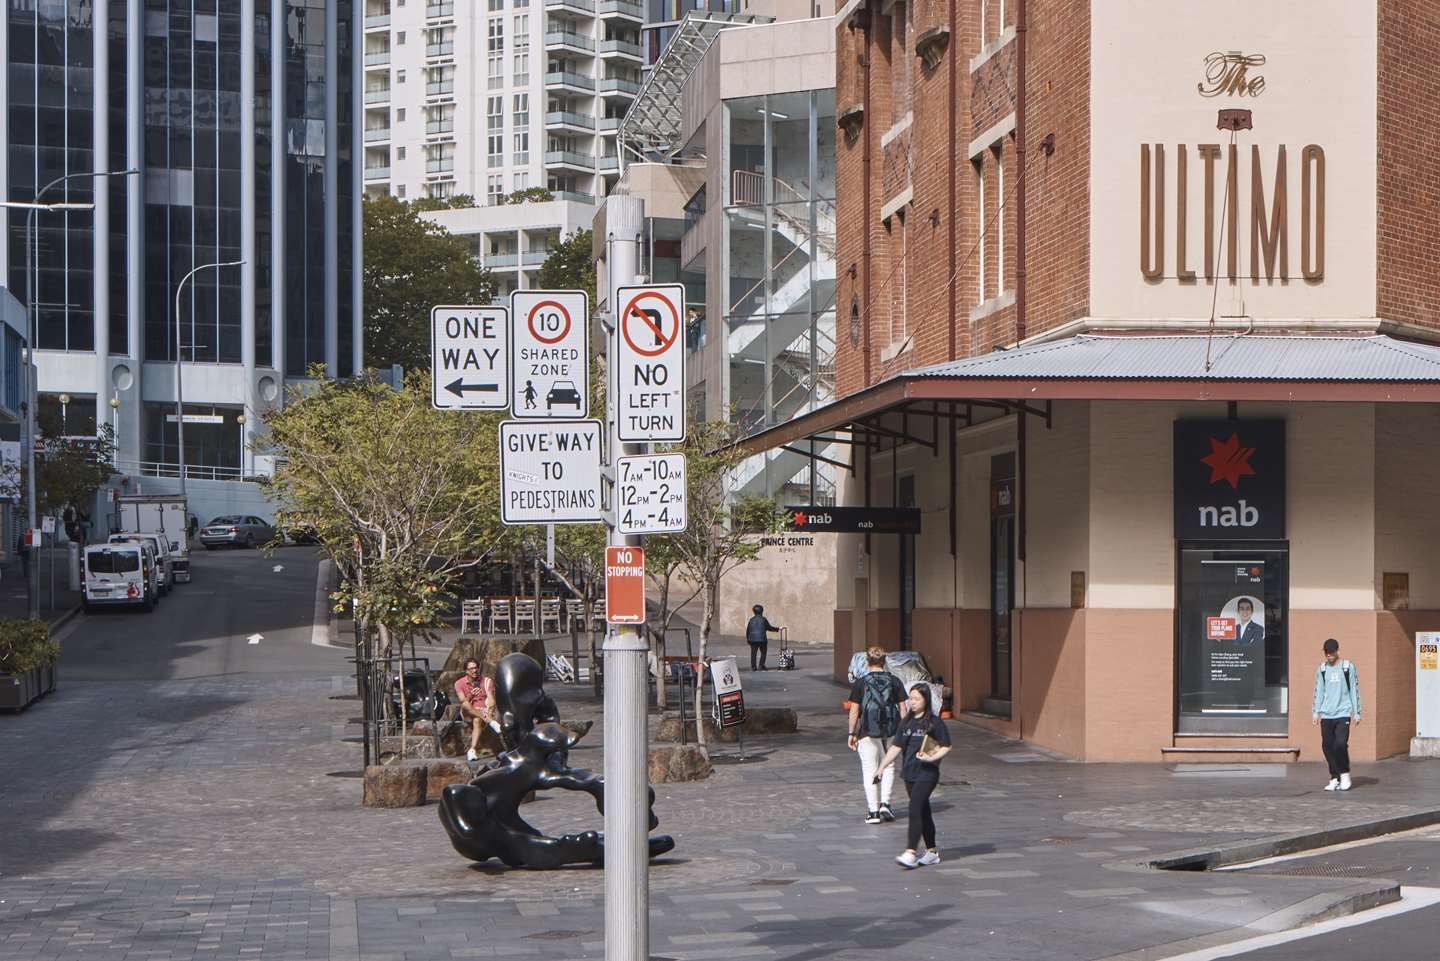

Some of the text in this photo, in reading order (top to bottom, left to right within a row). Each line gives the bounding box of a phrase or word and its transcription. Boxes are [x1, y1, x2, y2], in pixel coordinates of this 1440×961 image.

[1198, 51, 1266, 97] The
[1141, 143, 1325, 281] ULTIMO
[446, 317, 496, 338] ONE
[539, 313, 560, 332] 10
[442, 348, 500, 370] WAY
[521, 349, 579, 360] SHARED
[531, 365, 568, 376] ZONE
[634, 364, 668, 386] NO
[629, 394, 669, 408] LEFT
[629, 416, 673, 431] TURN
[508, 433, 594, 452] GIVE WAY
[542, 462, 563, 480] TO
[512, 490, 595, 509] PEDESTRIANS
[808, 513, 833, 525] nab
[1199, 500, 1259, 527] nab
[857, 520, 874, 528] nab
[762, 537, 814, 546] PRINCE CENTRE
[617, 551, 632, 564] NO
[607, 566, 643, 577] STOPPING
